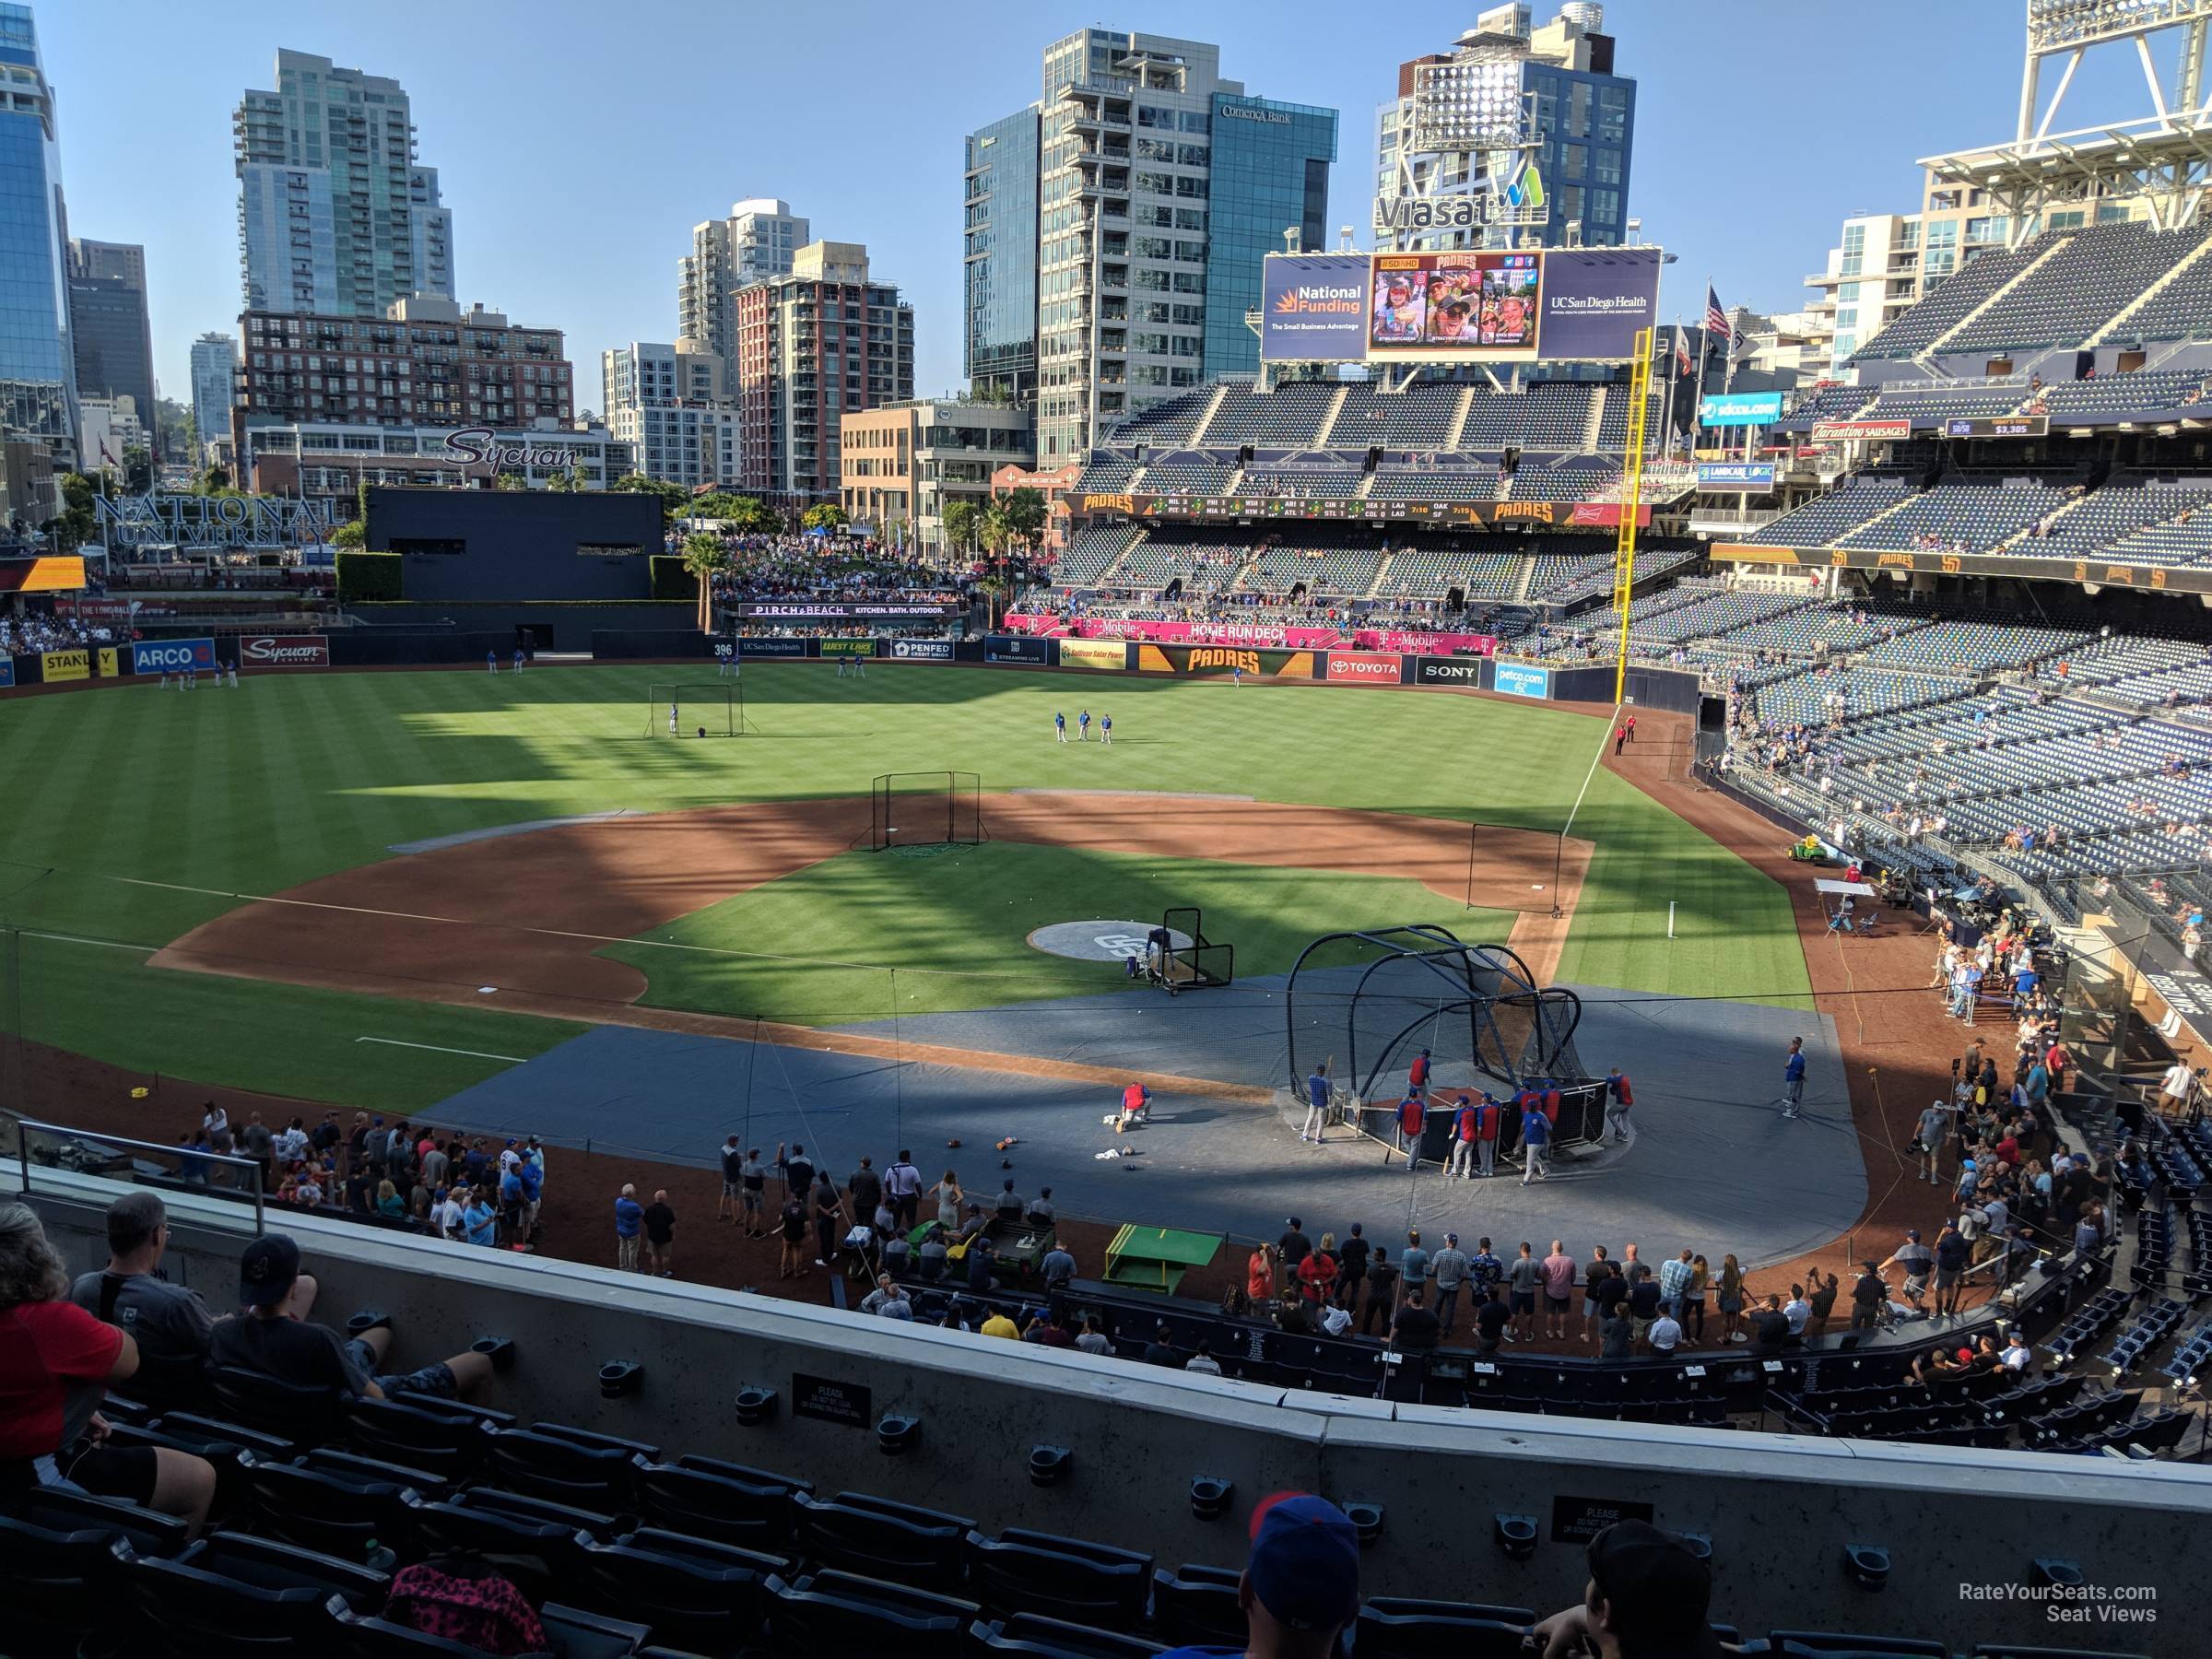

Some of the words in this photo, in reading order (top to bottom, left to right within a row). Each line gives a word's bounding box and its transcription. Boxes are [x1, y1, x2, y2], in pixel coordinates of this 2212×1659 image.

[1268, 111, 1290, 124] Bank
[1378, 193, 1494, 228] Viasat
[1437, 255, 1477, 270] PADRES
[1299, 285, 1361, 300] National
[1299, 300, 1360, 314] Funding
[1551, 297, 1568, 308] UC
[1568, 297, 1586, 308] San
[1587, 296, 1615, 310] Diego
[1616, 296, 1646, 307] Health
[1327, 323, 1359, 331] Advantage
[1718, 403, 1776, 417] sdccu.com
[1814, 424, 1864, 438] Tarantino
[1865, 427, 1907, 437] SAUSAGES
[1995, 425, 2028, 434] $3,305
[442, 427, 582, 477] Sycuan
[1711, 466, 1747, 477] LANDCARE
[1749, 466, 1773, 477] LOGIC
[92, 493, 347, 526] NATIONAL
[1083, 494, 1134, 514] PADRES
[1494, 501, 1553, 523] PADRES
[116, 524, 327, 546] UNIVERSITY
[1877, 554, 1914, 569] PADRES
[756, 606, 798, 615] PIRCH
[807, 606, 844, 615] BEACH
[1191, 624, 1226, 637] HOME
[1227, 626, 1255, 638] RUN
[245, 639, 320, 663] Sycuan
[714, 643, 733, 656] 396
[765, 643, 782, 652] Diego
[849, 642, 871, 651] LAKE
[911, 643, 949, 653] PENFED
[137, 647, 193, 667] ARCO
[1070, 649, 1092, 658] Sullivan
[1092, 650, 1107, 658] Solar
[1107, 651, 1124, 659] Power
[1188, 648, 1260, 676] PADRES
[1349, 662, 1398, 675] TOYOTA
[1425, 665, 1475, 678] SONY
[1499, 670, 1543, 685] petco.com
[1586, 1507, 1619, 1520] PLEASE
